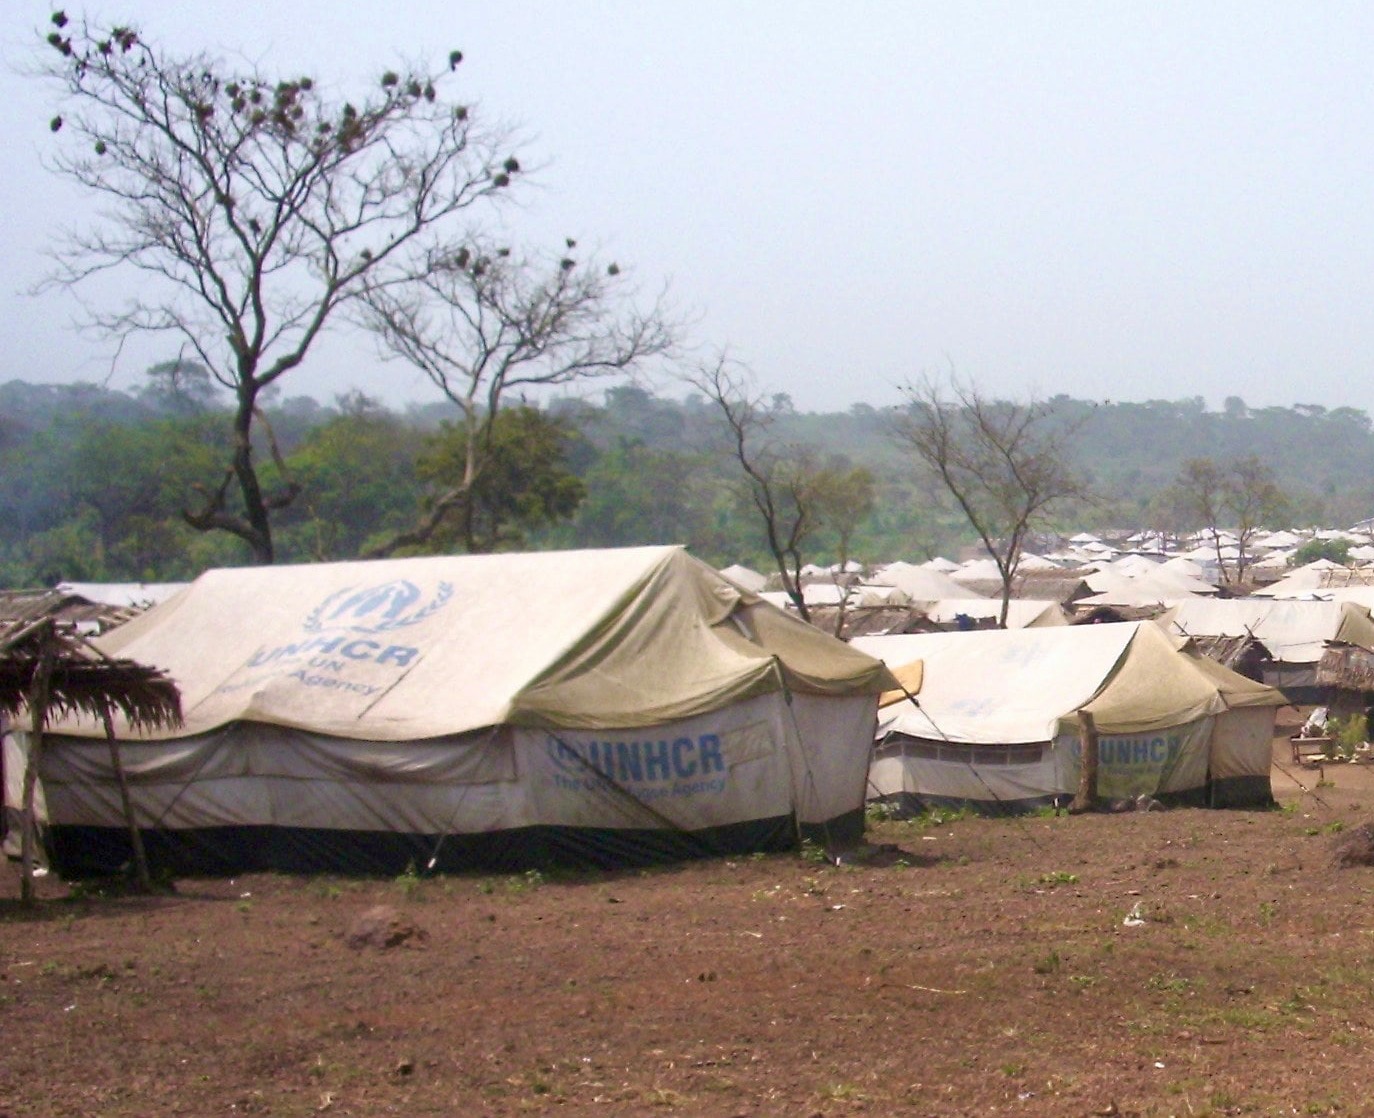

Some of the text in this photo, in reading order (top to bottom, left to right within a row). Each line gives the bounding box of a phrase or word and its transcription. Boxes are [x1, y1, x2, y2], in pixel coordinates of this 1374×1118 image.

[248, 636, 419, 668] UNHCR
[308, 657, 344, 672] UN
[289, 669, 382, 697] Agency
[589, 733, 725, 782] UNHCR
